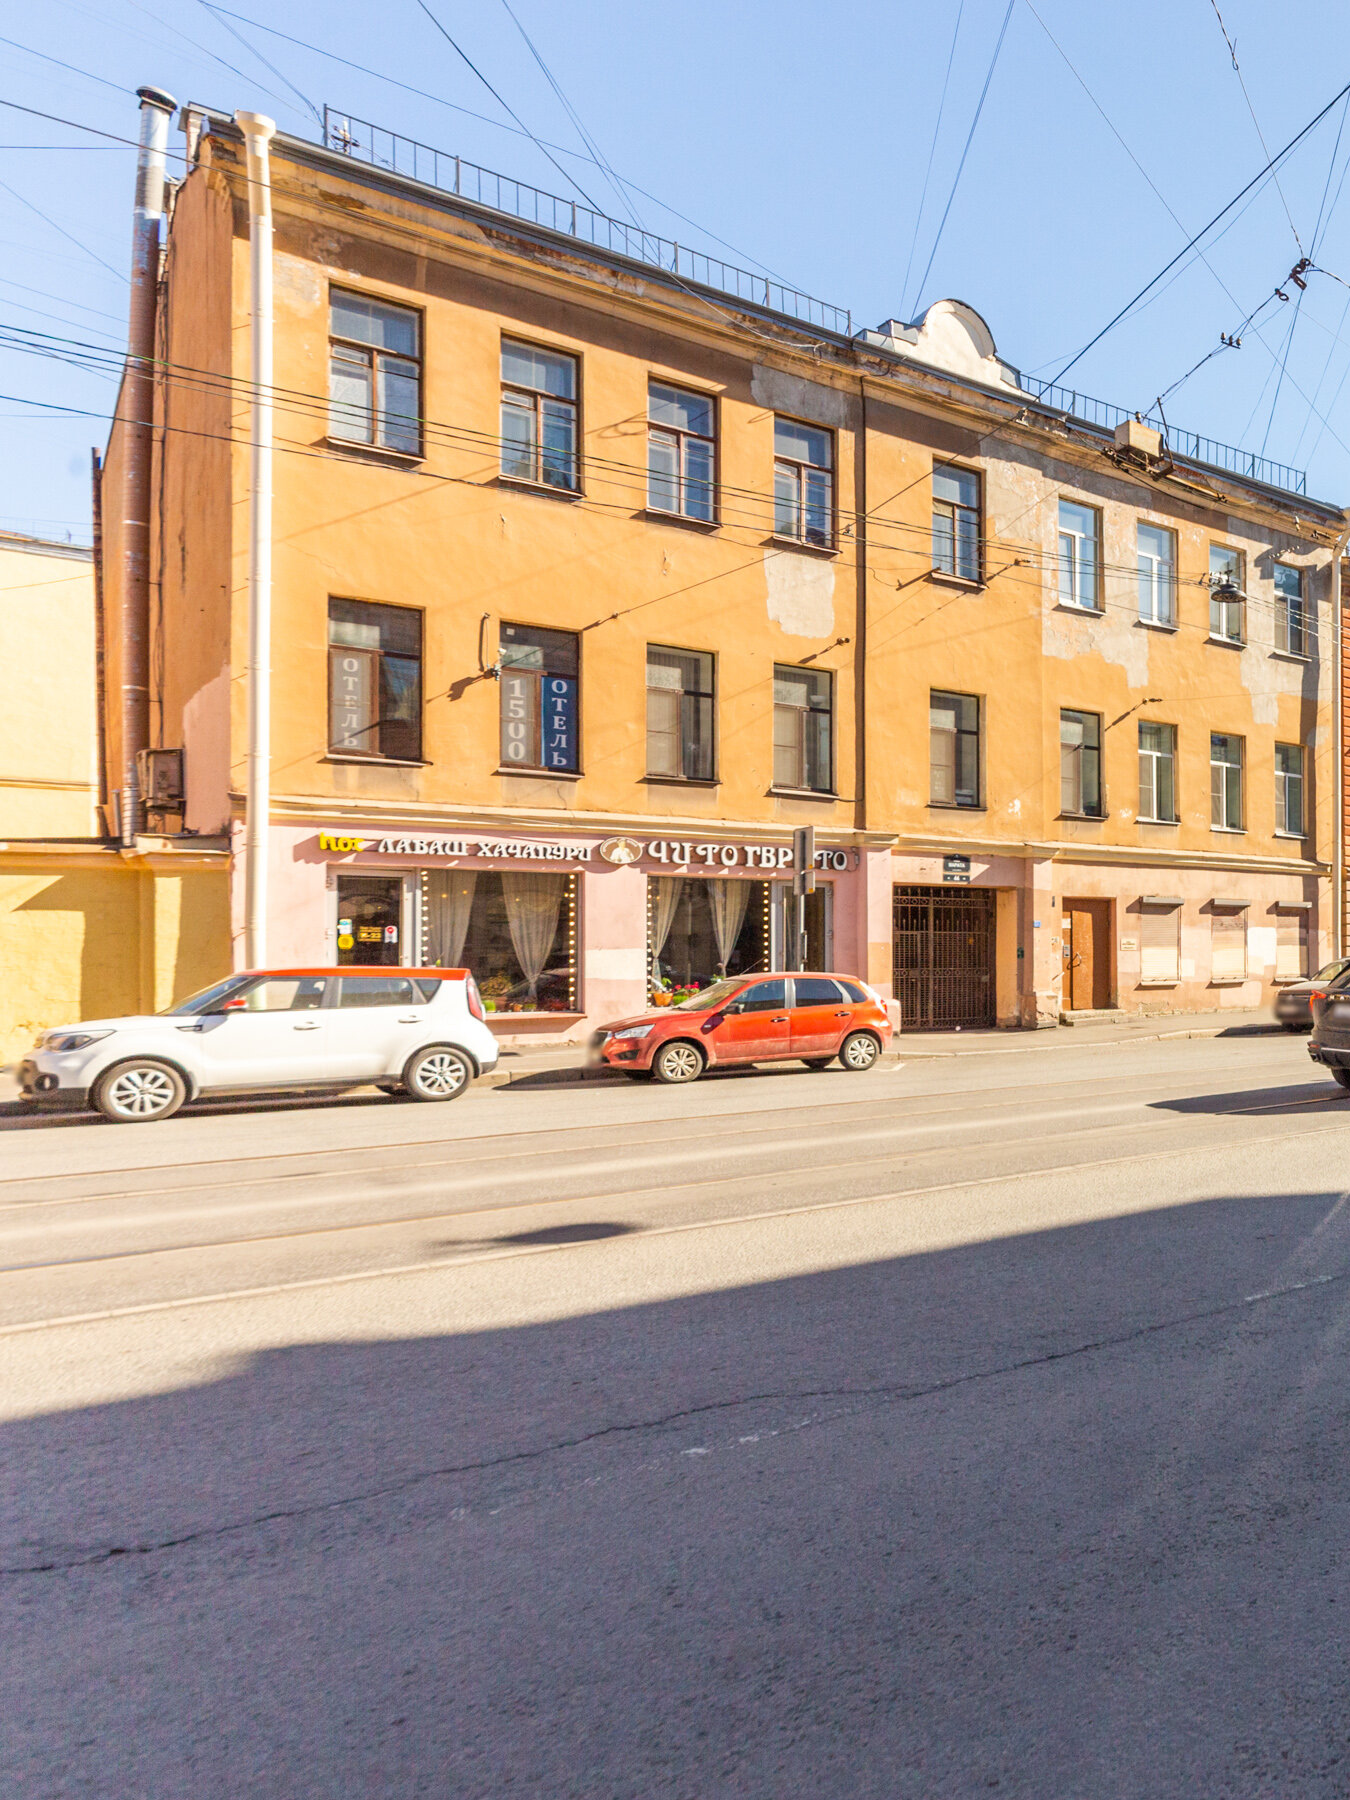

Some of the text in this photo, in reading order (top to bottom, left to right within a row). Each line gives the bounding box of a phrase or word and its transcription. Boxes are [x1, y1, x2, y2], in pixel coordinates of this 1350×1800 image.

[342, 658, 359, 747] ОТЕЛЬ
[508, 679, 525, 760] 1500
[550, 679, 568, 766] ОТЕЛЬ
[378, 838, 468, 857] ЛАВАШ
[477, 842, 592, 862] ХАЧАПУРИ
[744, 845, 847, 871] ГВРТО
